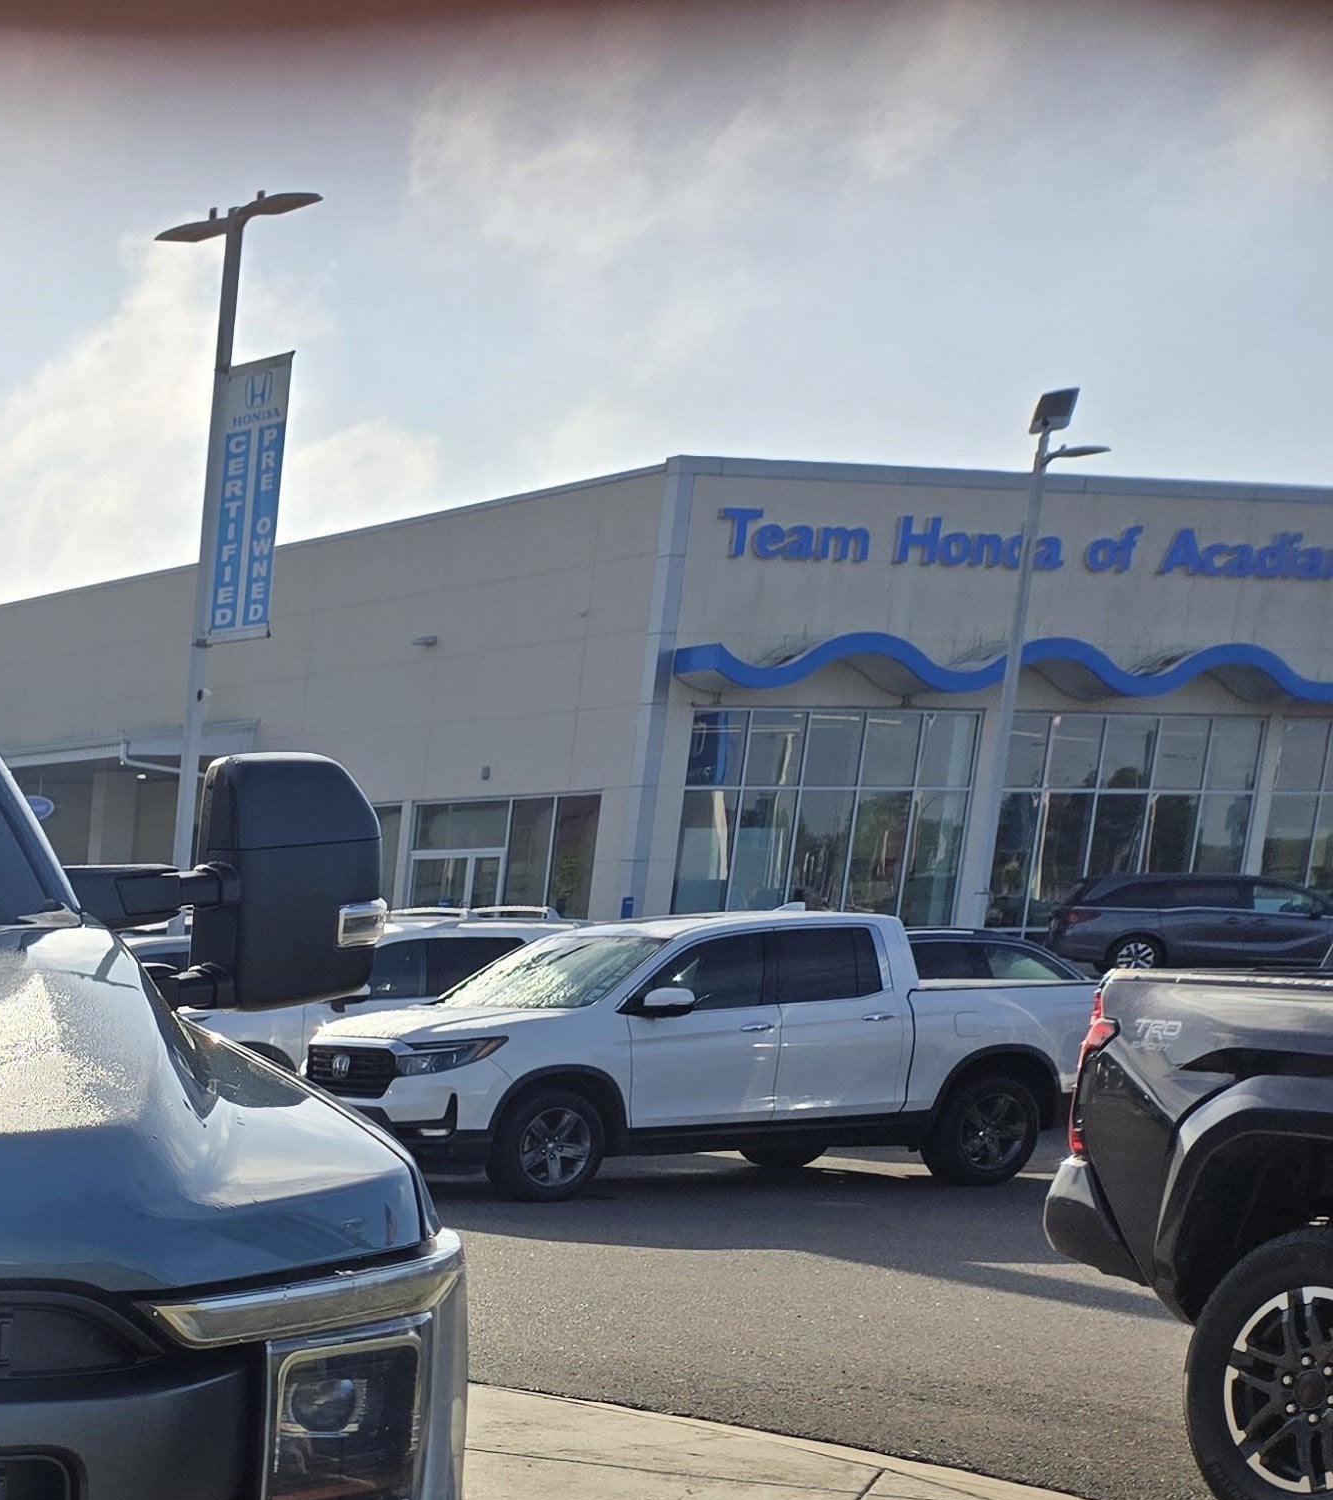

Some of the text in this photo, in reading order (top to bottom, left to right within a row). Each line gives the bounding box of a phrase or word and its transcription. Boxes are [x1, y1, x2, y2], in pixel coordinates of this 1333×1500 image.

[214, 435, 248, 626] CERTIFIED
[248, 428, 278, 622] PRE OWNED
[719, 507, 870, 561] Team
[1087, 525, 1144, 572] of
[1158, 527, 1333, 580] Acadia
[1135, 1018, 1183, 1040] TRD
